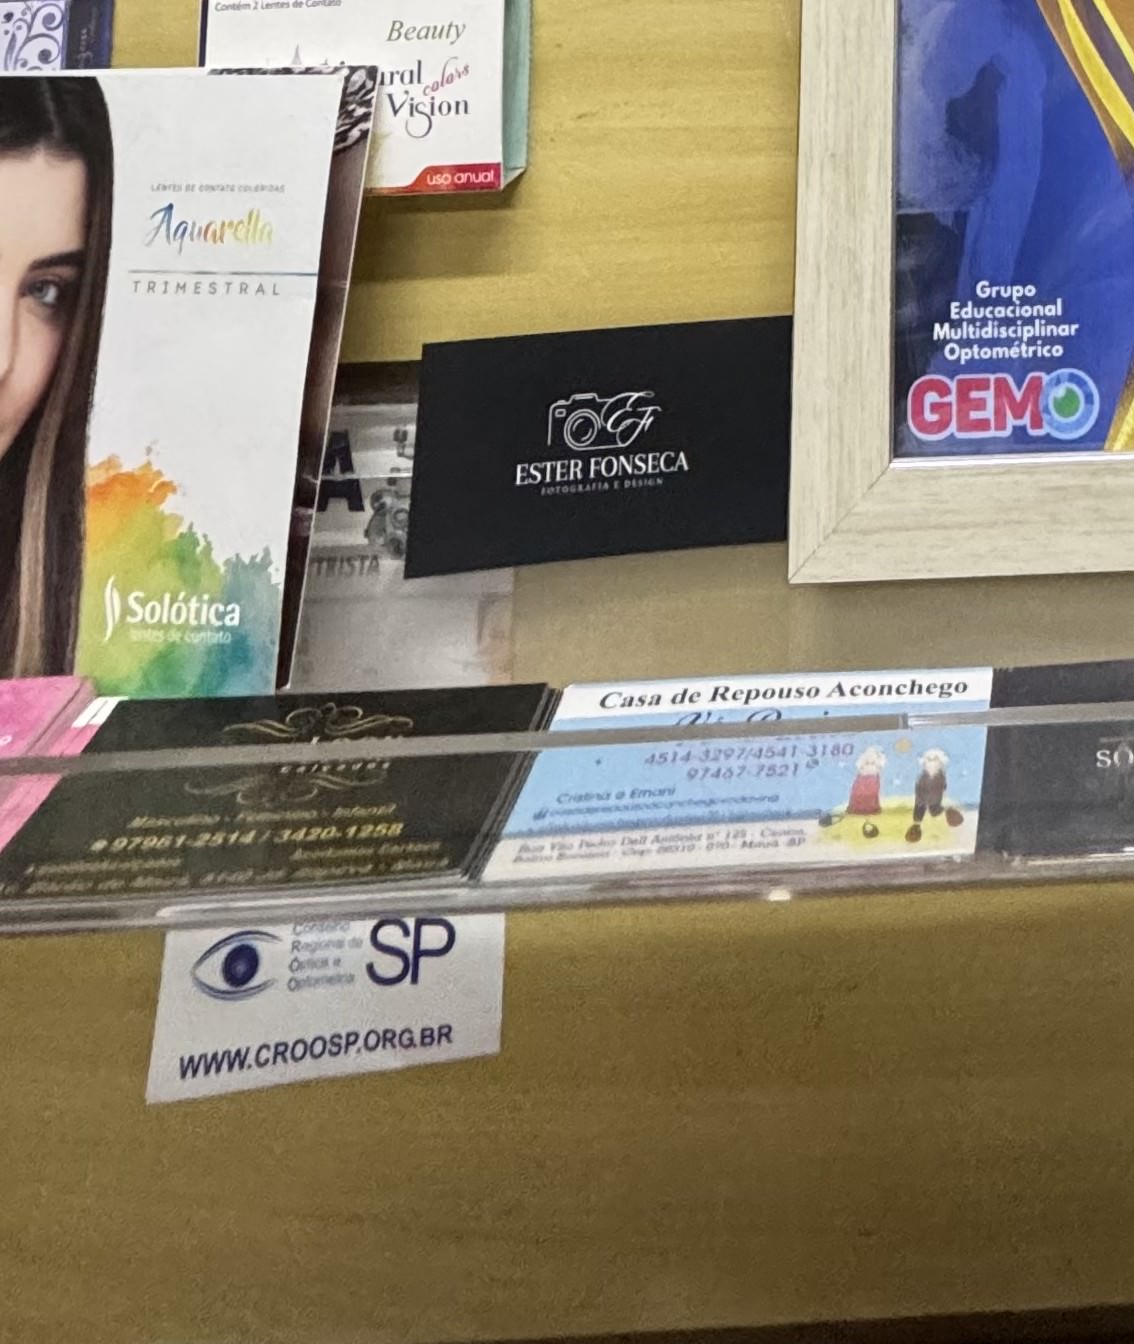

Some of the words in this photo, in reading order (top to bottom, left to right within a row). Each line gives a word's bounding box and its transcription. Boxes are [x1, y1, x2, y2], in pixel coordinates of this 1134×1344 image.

[386, 19, 467, 46] Beauty
[423, 56, 470, 97] colors
[387, 90, 470, 139] Vision
[427, 172, 451, 186] uso
[454, 168, 495, 185] anual
[144, 202, 274, 256] Aquarella
[133, 280, 281, 297] TRIMESTRAL
[975, 280, 1037, 301] Grupo
[950, 298, 1063, 319] Educacional
[932, 321, 1080, 343] Multidisciplinar
[943, 341, 1064, 364] Optométrico
[515, 458, 582, 486] ESTER
[589, 451, 690, 480] FONSECA
[126, 590, 241, 628] Solótica
[599, 691, 662, 710] Casa
[670, 688, 702, 705] de
[710, 684, 821, 704] Repouso
[827, 678, 969, 699] Aconchego
[366, 917, 457, 986] SP
[179, 1024, 454, 1080] WWW.CROOSP.ORG.BR
